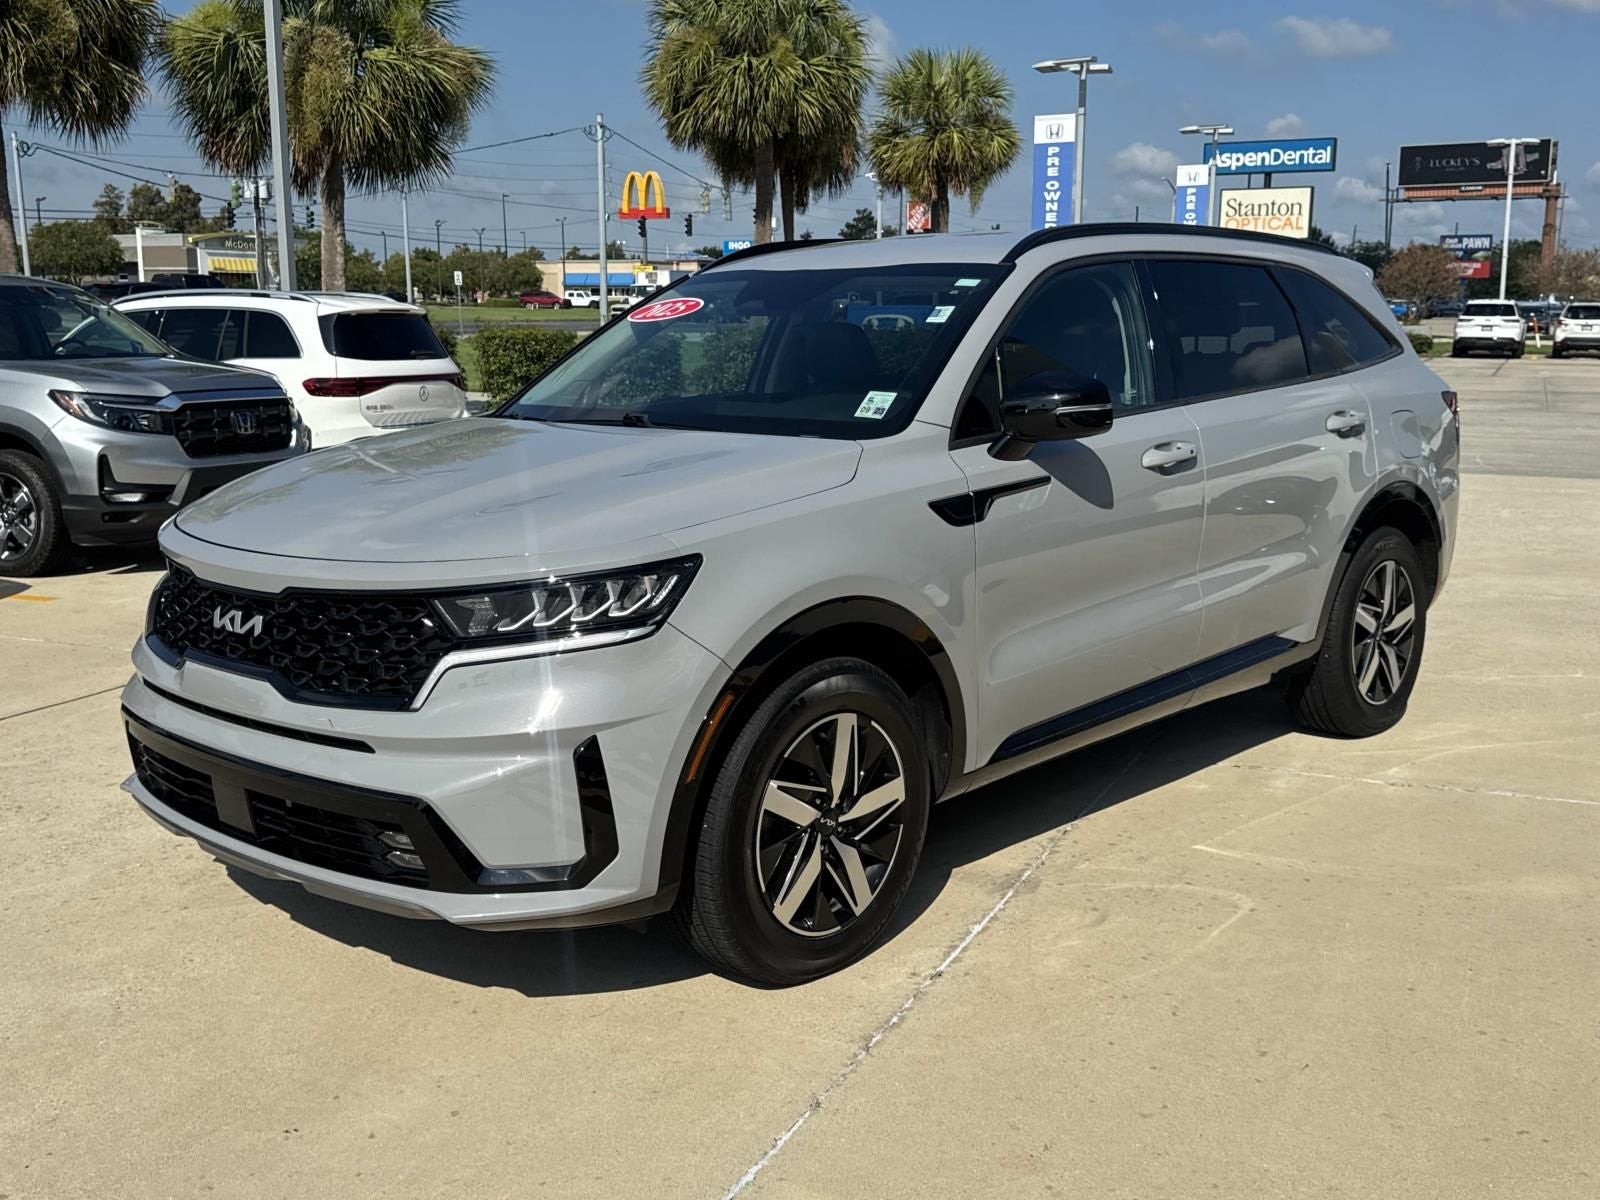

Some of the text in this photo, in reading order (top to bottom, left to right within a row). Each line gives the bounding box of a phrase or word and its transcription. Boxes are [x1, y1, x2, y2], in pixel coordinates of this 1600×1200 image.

[1047, 146, 1060, 176] PRE
[1225, 198, 1303, 218] Stanton
[1225, 216, 1304, 231] OPTICAL
[225, 239, 256, 249] McDon
[1462, 236, 1490, 249] PAWN
